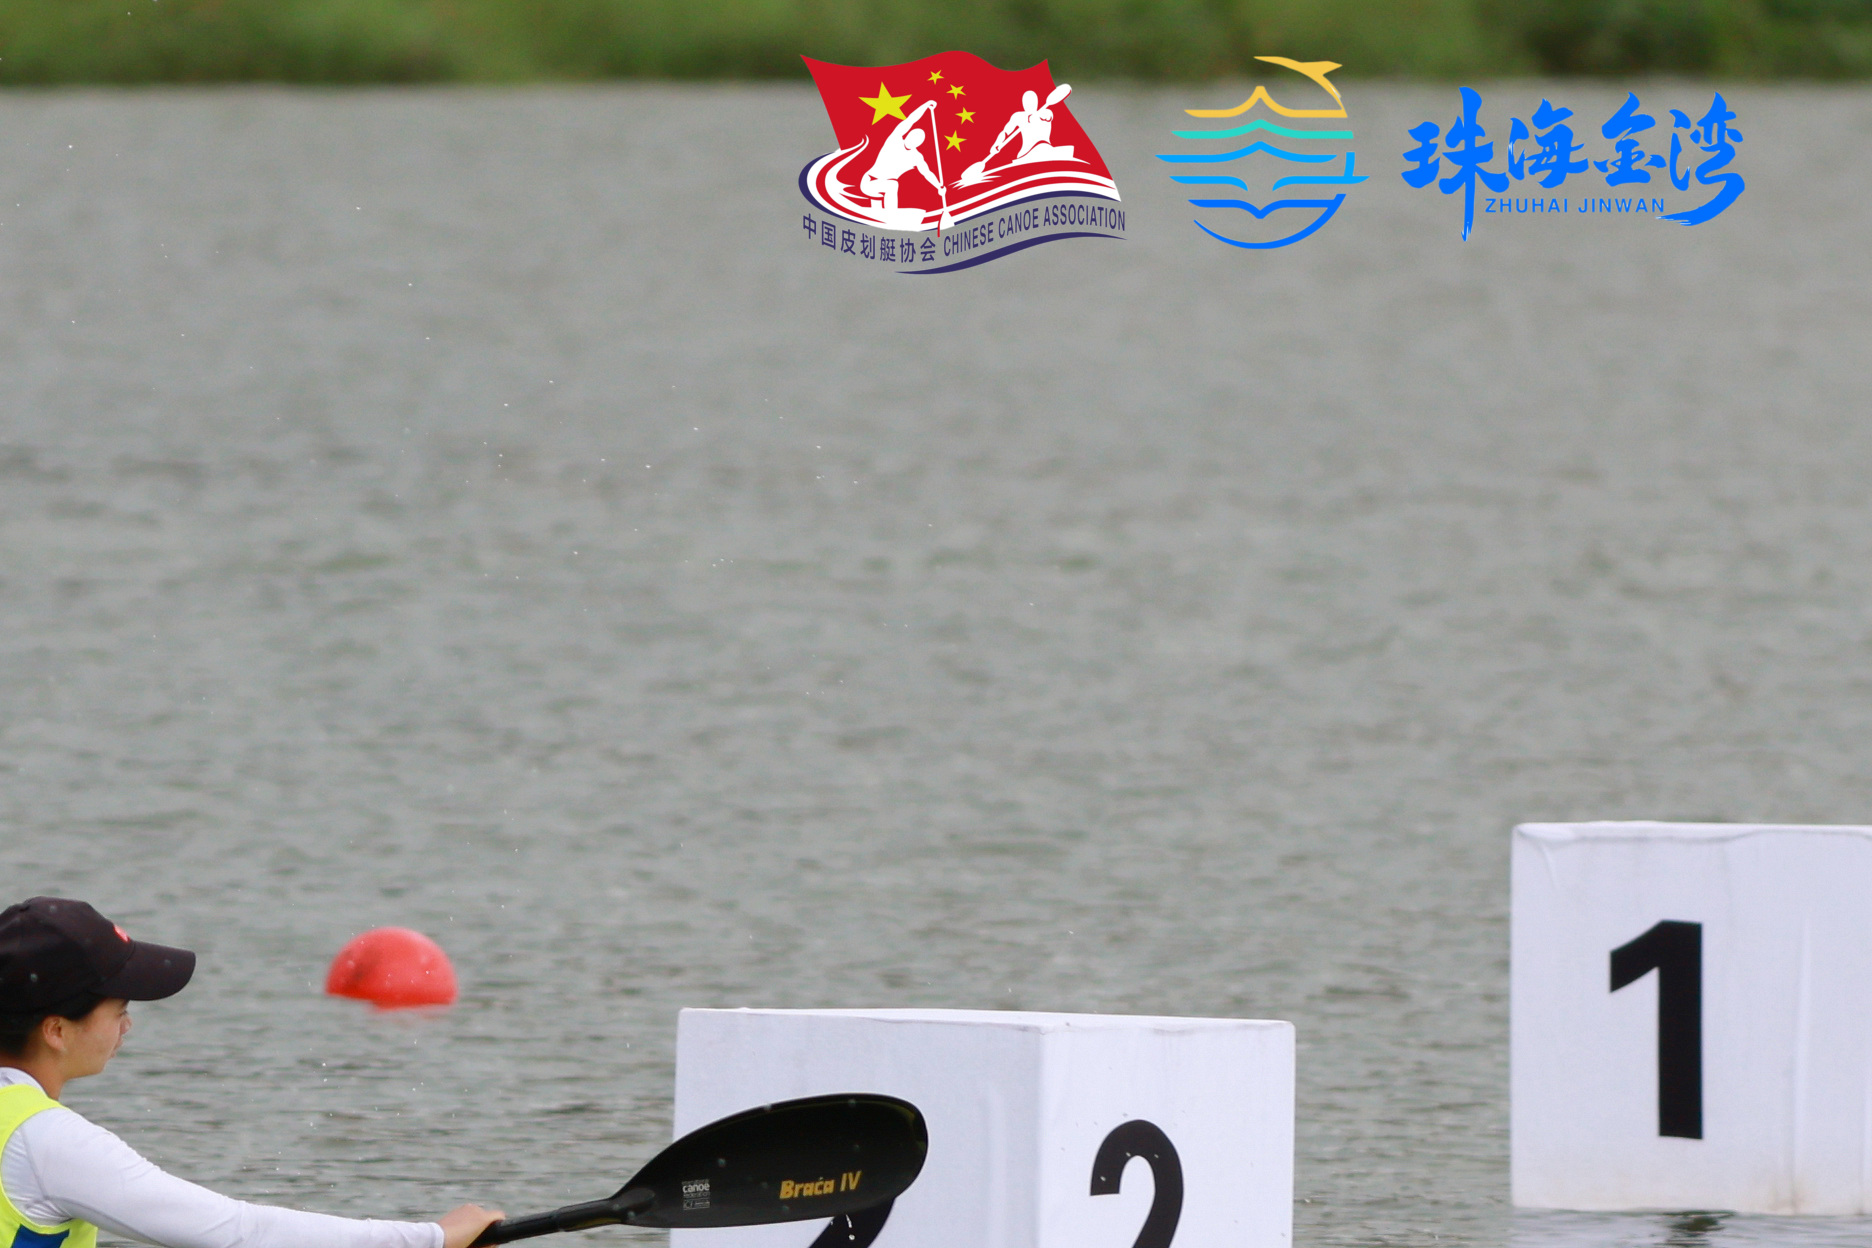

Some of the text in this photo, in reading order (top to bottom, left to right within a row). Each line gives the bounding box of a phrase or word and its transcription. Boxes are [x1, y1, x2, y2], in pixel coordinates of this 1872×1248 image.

[1610, 919, 1703, 1140] 1
[682, 1183, 710, 1193] canoe
[779, 1170, 862, 1199] Braća IV
